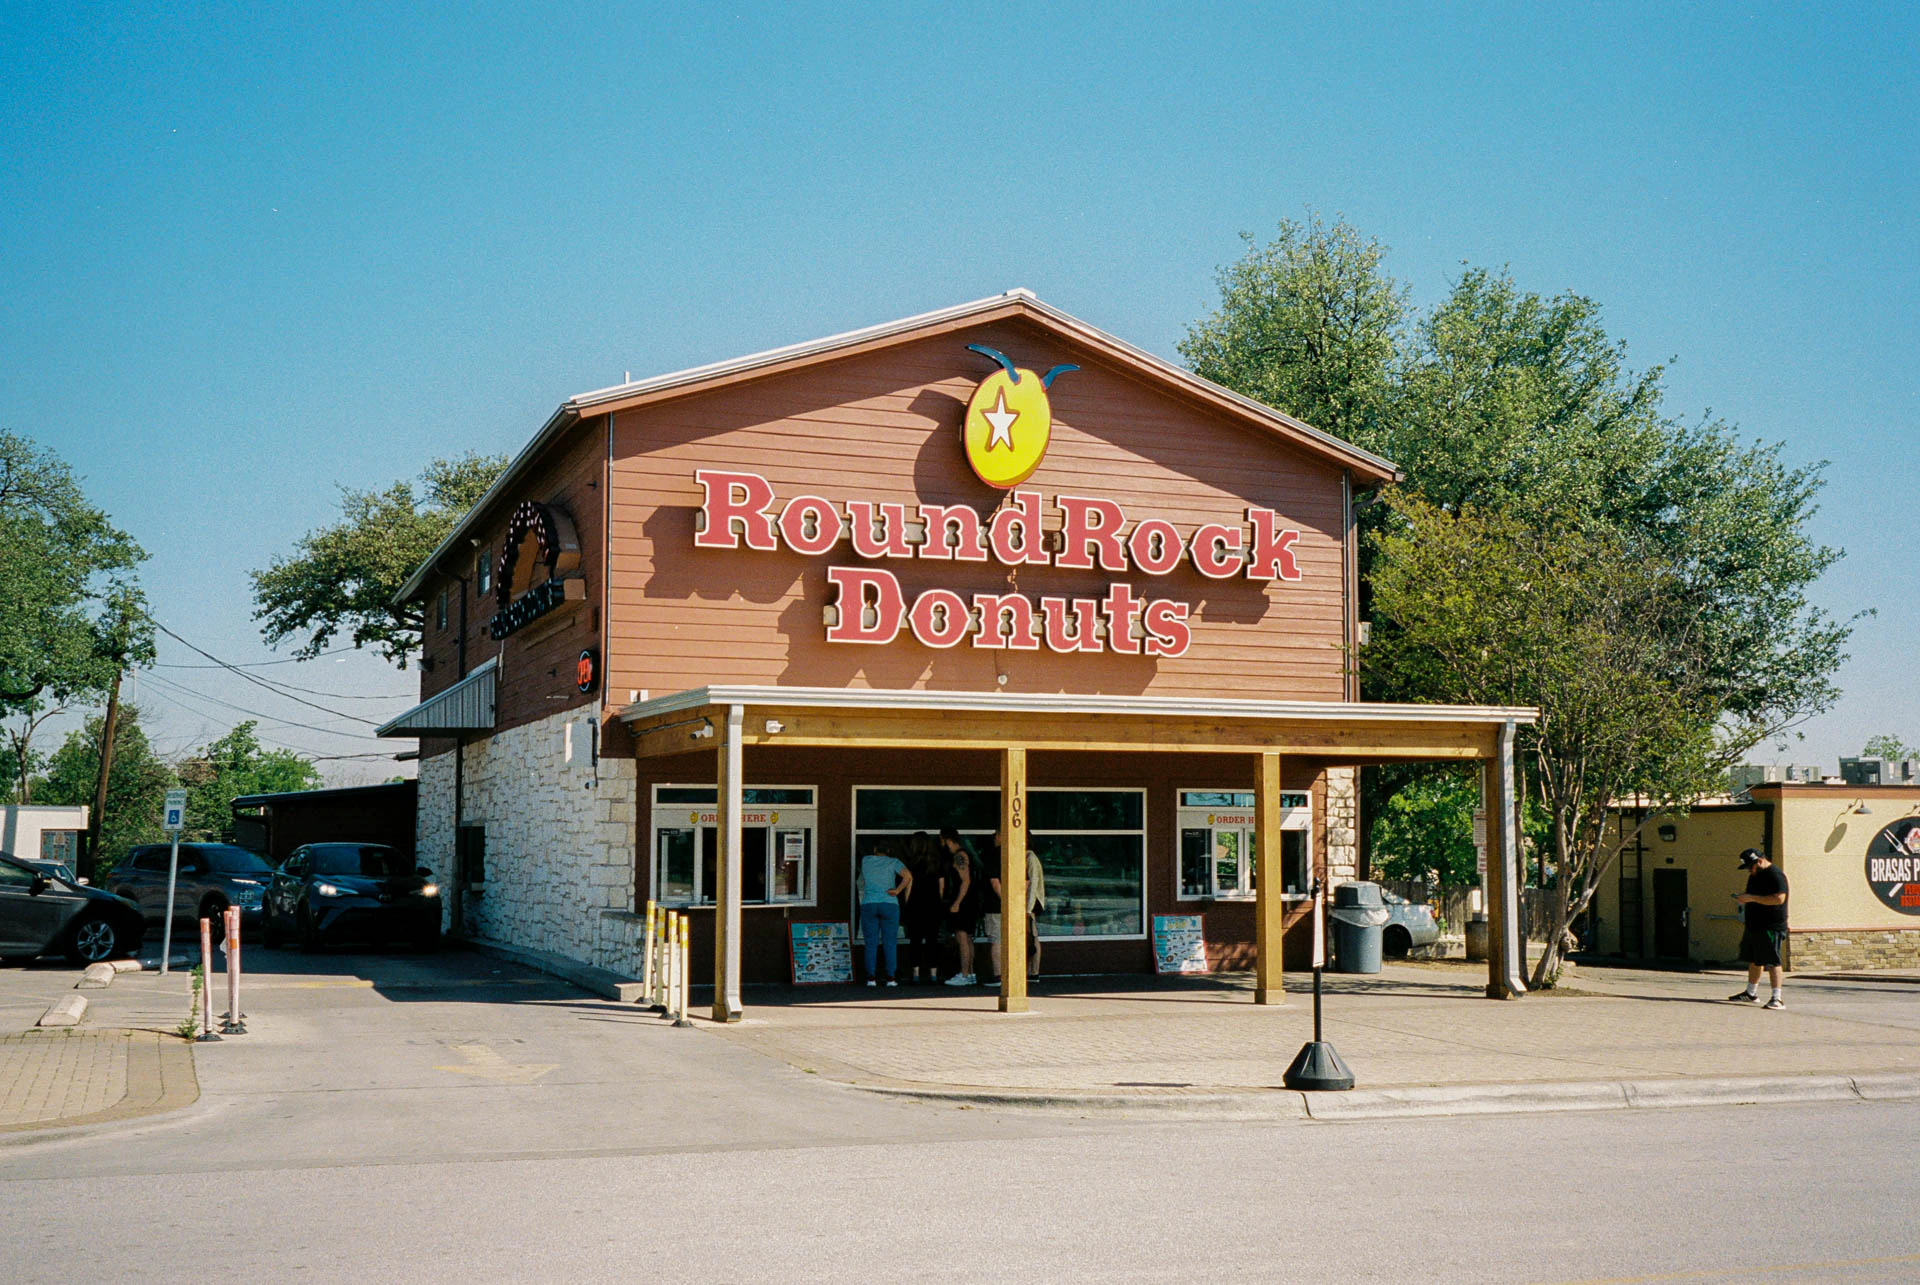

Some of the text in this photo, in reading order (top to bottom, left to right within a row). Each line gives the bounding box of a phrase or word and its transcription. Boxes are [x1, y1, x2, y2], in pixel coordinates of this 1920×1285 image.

[695, 469, 1302, 582] Round Rock
[827, 566, 1192, 658] Donuts
[1012, 780, 1022, 828] 106
[1216, 816, 1246, 824] ORDER
[1871, 858, 1920, 882] BRASAS P
